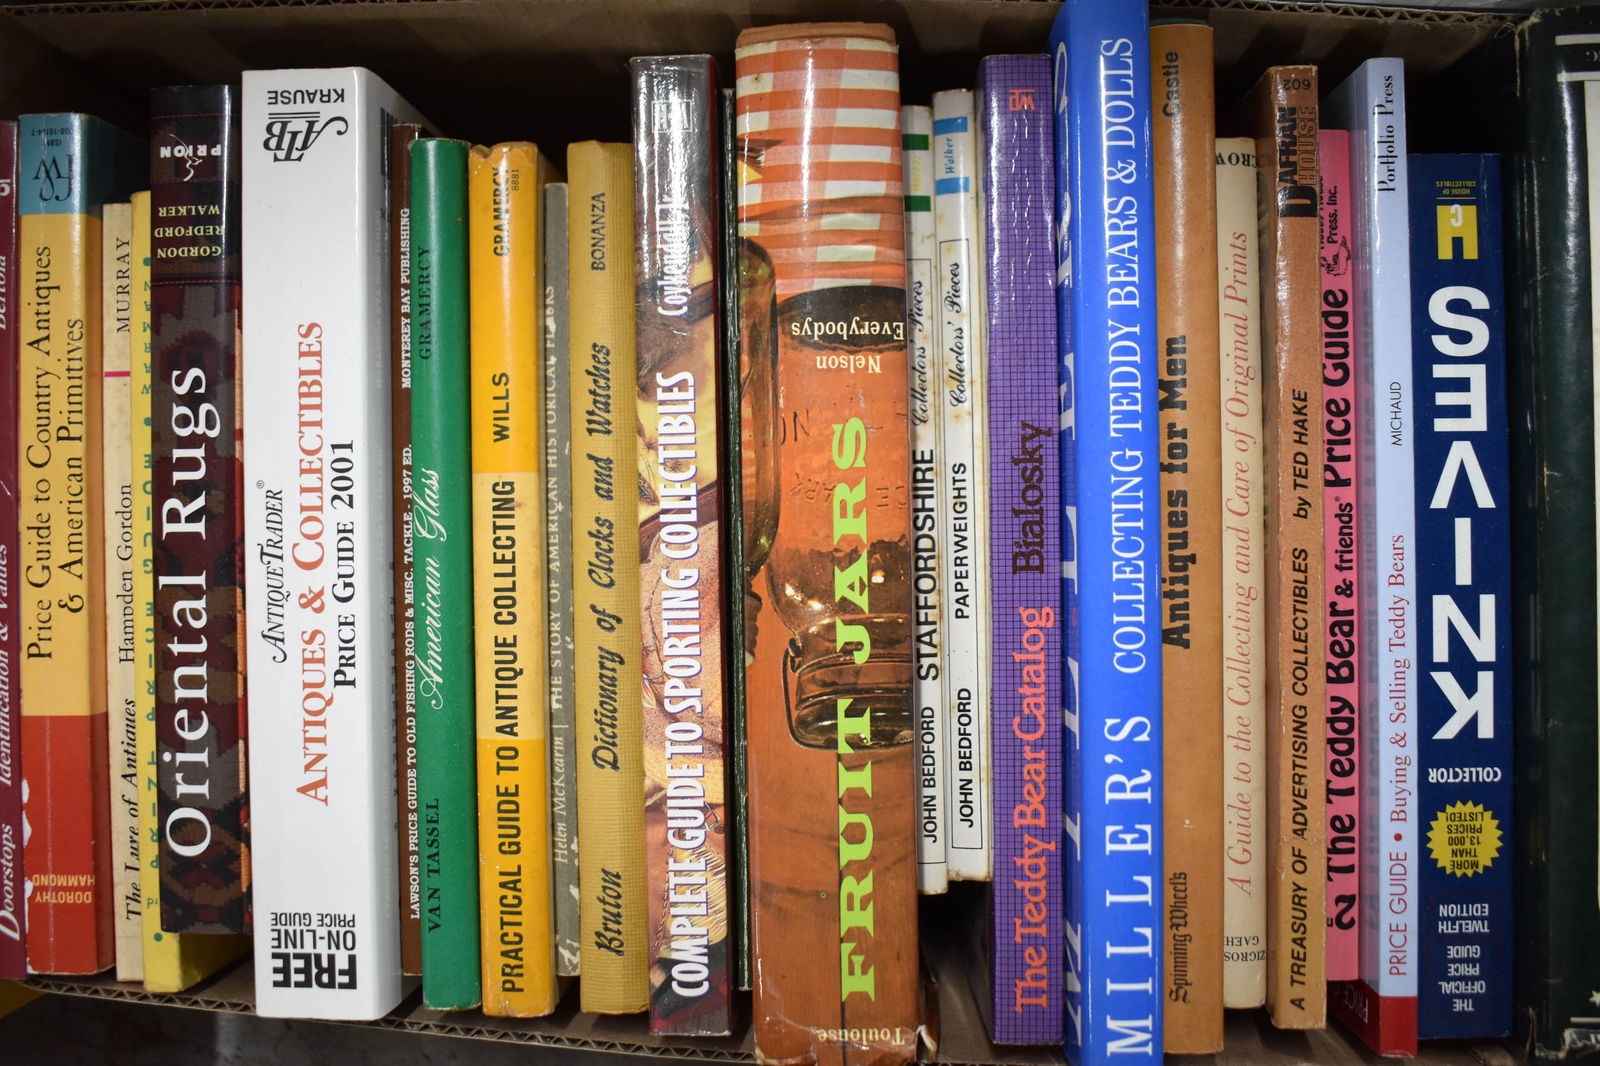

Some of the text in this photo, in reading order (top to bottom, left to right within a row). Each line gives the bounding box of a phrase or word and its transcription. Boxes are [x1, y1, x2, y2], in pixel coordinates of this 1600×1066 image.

[267, 88, 345, 104] KRAUSE
[1163, 51, 1180, 118] Castle
[1283, 79, 1311, 91] 602
[511, 169, 520, 191] 8881
[943, 136, 955, 174] Walker
[1297, 106, 1317, 187] HOUSE
[1373, 75, 1399, 191] Portfolio Press
[154, 225, 224, 237] REDFORD
[156, 245, 221, 257] GORDON
[158, 205, 220, 216] WALKER
[491, 166, 511, 257] GRAMERCY
[590, 191, 606, 270] BONANZA
[116, 238, 129, 334] MURRAY
[400, 207, 411, 389] MONTEREY BAY PUBLISHING
[416, 244, 432, 360] GRAMERCY
[790, 321, 905, 341] Everybodys
[945, 261, 970, 407] Collectors' Pieces
[815, 355, 880, 373] Nelson
[1100, 37, 1147, 673] COLLECTING TEDDY BEARS & DOLLS
[25, 245, 60, 661] Price Guide to Country Antiques
[490, 372, 510, 443] WILLS
[1389, 381, 1402, 446] MICHAUD
[55, 318, 83, 613] & American Primitives
[545, 355, 559, 667] STORY HISTORICAL
[1011, 420, 1051, 576] Bialosky
[1158, 335, 1196, 649] Antiques for Men
[1427, 286, 1496, 739] KNIVES
[113, 484, 136, 664] Hampden Gordon
[293, 321, 333, 807] ANTIQUES & COLLECTIBLES
[330, 439, 356, 689] PRICE GUIDE 2001
[411, 465, 447, 710] American Glass
[585, 342, 627, 770] Dictionary of Clocks and Watches
[912, 449, 940, 681] STAFFORDSHIRE
[952, 462, 969, 619] PAPERWEIGHTS
[1224, 232, 1259, 897] A Guide to the Collecting and Care Original Prints
[158, 367, 220, 858] Oriental Rugs
[402, 468, 421, 920] LAWSON'S PRICE GUIDE TO OLD FISHING RODS MISC. TACKLE 1997
[656, 370, 710, 997] COMPLETE GUIDE TO SPORTING COLLECTIBLES
[831, 416, 875, 1003] FRUIT JARS
[1289, 389, 1312, 1010] A TREASURY OF ADVERTISING COLLECTIBLES by TED HAKE
[491, 480, 525, 993] PRACTICAL GUIDE TO ANTIQUE COLLECTING
[920, 705, 937, 843] JOHN BEDFORD
[958, 688, 977, 829] JOHN BEDFORD
[1325, 602, 1355, 881] The Teddy Bear
[1383, 535, 1410, 976] PRICE GUIDE Buying & Selling Teddy Bears
[1427, 767, 1502, 783] COLLECTOR
[550, 735, 567, 863] Helen McKearin
[1012, 607, 1056, 1013] The Teddy Bear Catalog
[1446, 812, 1484, 823] LISTED!
[1446, 824, 1483, 835] PRICES
[1447, 836, 1481, 848] 13,000
[0, 823, 20, 941] Doorstops
[32, 872, 95, 887] HAMMOND
[35, 891, 91, 905] DOROTHY
[121, 795, 141, 920] The Lure of
[424, 797, 442, 933] VAN TASSEL
[1104, 715, 1153, 1058] MILLER'S
[1450, 860, 1479, 870] MORE
[1451, 848, 1478, 858] THAN
[271, 912, 356, 928] PRICE GUIDE
[272, 928, 357, 951] ON-LINE
[594, 868, 625, 957] Bruton
[1438, 920, 1490, 933] TWELFTH
[1439, 904, 1489, 917] EDITION
[1447, 946, 1480, 958] GUIDE
[271, 952, 357, 990] FREE
[1169, 932, 1193, 1004] Spinning
[1438, 981, 1486, 994] OFFICIAL
[1448, 964, 1479, 976] PRICE
[1452, 999, 1474, 1011] THE
[816, 1027, 905, 1046] Toulouse
